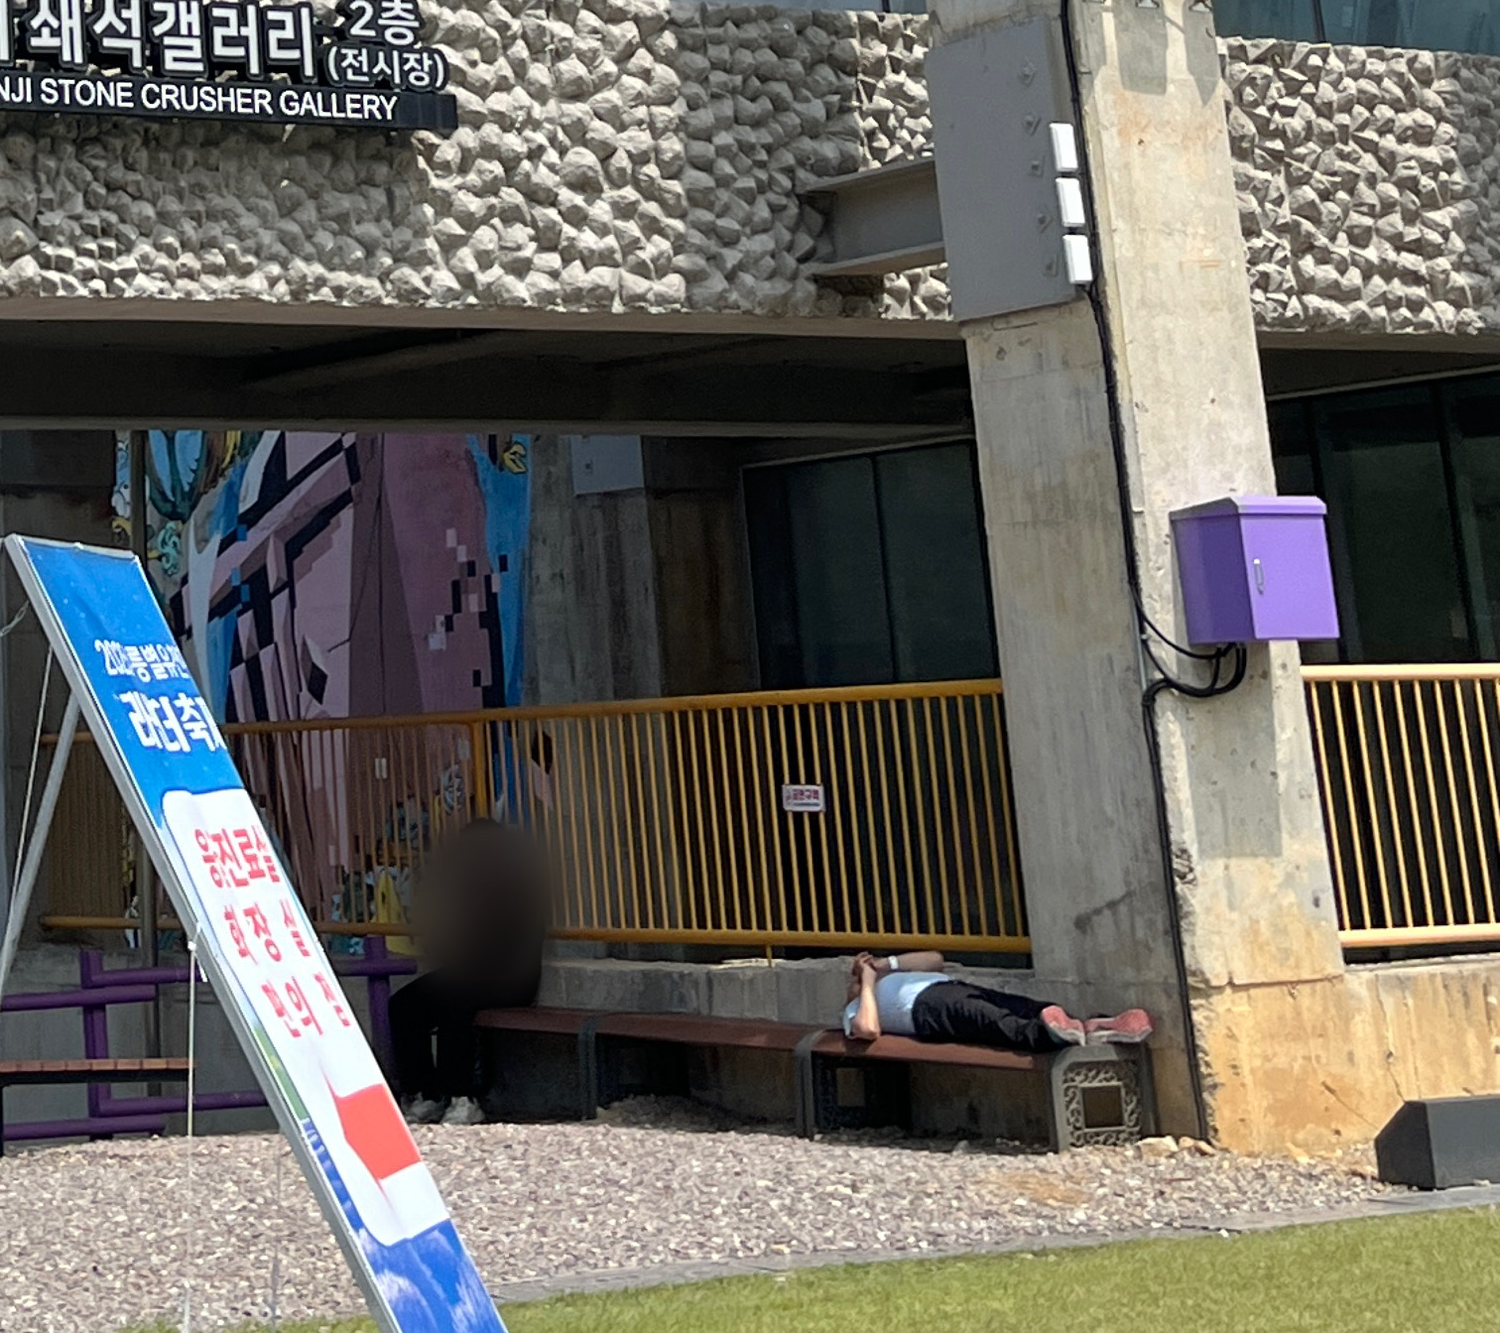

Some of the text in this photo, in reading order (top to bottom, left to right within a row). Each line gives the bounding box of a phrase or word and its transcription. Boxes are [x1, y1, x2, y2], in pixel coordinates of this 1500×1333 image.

[327, 44, 446, 89] (전시장)
[40, 81, 134, 108] STONE
[140, 83, 273, 115] CRUSHER
[279, 90, 398, 121] GALLERY
